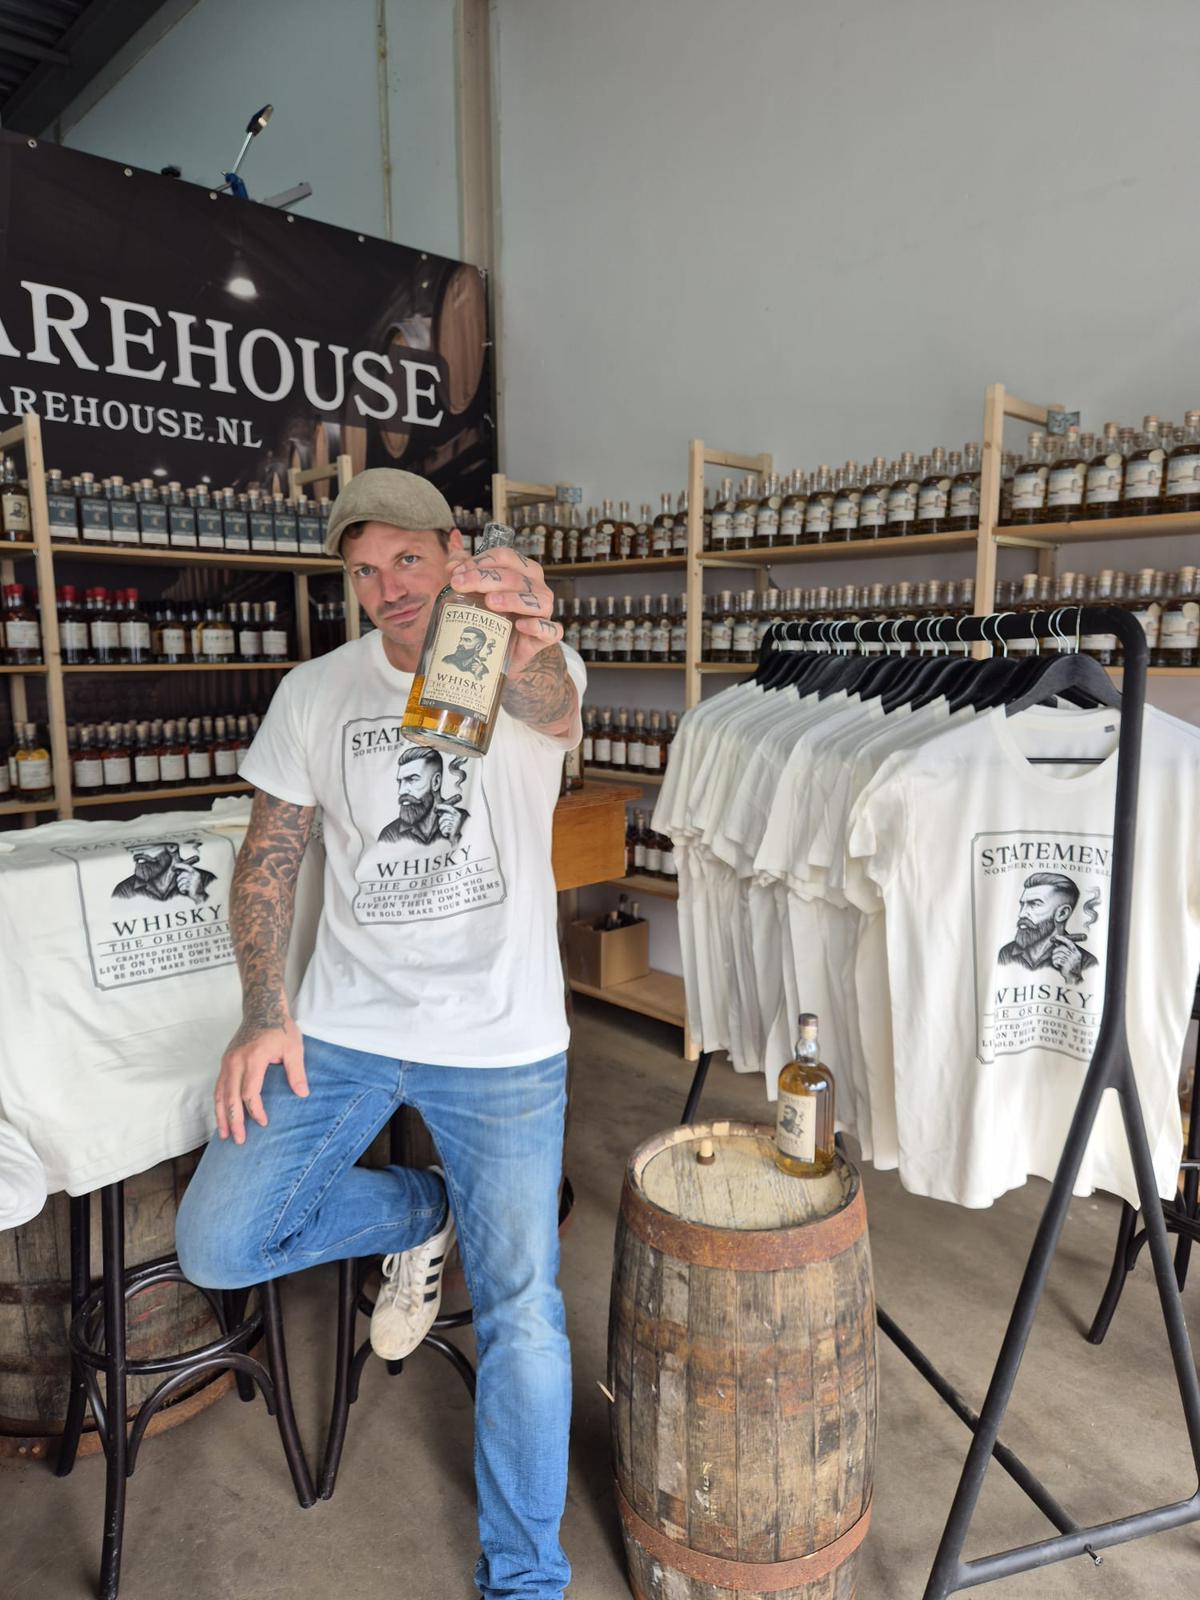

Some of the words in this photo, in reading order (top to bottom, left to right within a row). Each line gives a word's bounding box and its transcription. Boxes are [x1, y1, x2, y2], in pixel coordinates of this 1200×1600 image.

[0, 280, 443, 427] REHOUSE
[0, 385, 263, 448] REHOUSE.NL
[445, 610, 507, 636] STATEMENT
[437, 672, 486, 693] WHISKY
[352, 726, 401, 750] STAT
[377, 845, 471, 878] WHISKY
[982, 842, 1111, 867] STATEMEN
[368, 882, 400, 892] THE
[409, 863, 483, 889] ORIGINAL
[984, 862, 1034, 875] NORERN
[1039, 862, 1092, 874] BLENDED
[401, 898, 432, 908] THEIR
[438, 892, 461, 903] OWN
[466, 881, 500, 895] TERMS
[431, 885, 459, 896] THOSE
[462, 878, 483, 887] WHO
[438, 901, 460, 912] YOUR
[112, 904, 222, 937] WHISKY
[109, 940, 144, 952] THE
[116, 950, 157, 963] CRAFTED
[161, 946, 178, 955] FOR
[182, 941, 209, 951] THOSE
[99, 964, 126, 975] LIVE
[130, 960, 146, 969] ON
[150, 953, 184, 965] THEIR
[188, 947, 212, 957] OWN
[160, 961, 185, 971] MAKE
[189, 956, 210, 965] YOUR
[1037, 1019, 1068, 1030] THOSE
[1041, 1026, 1068, 1038] OWN
